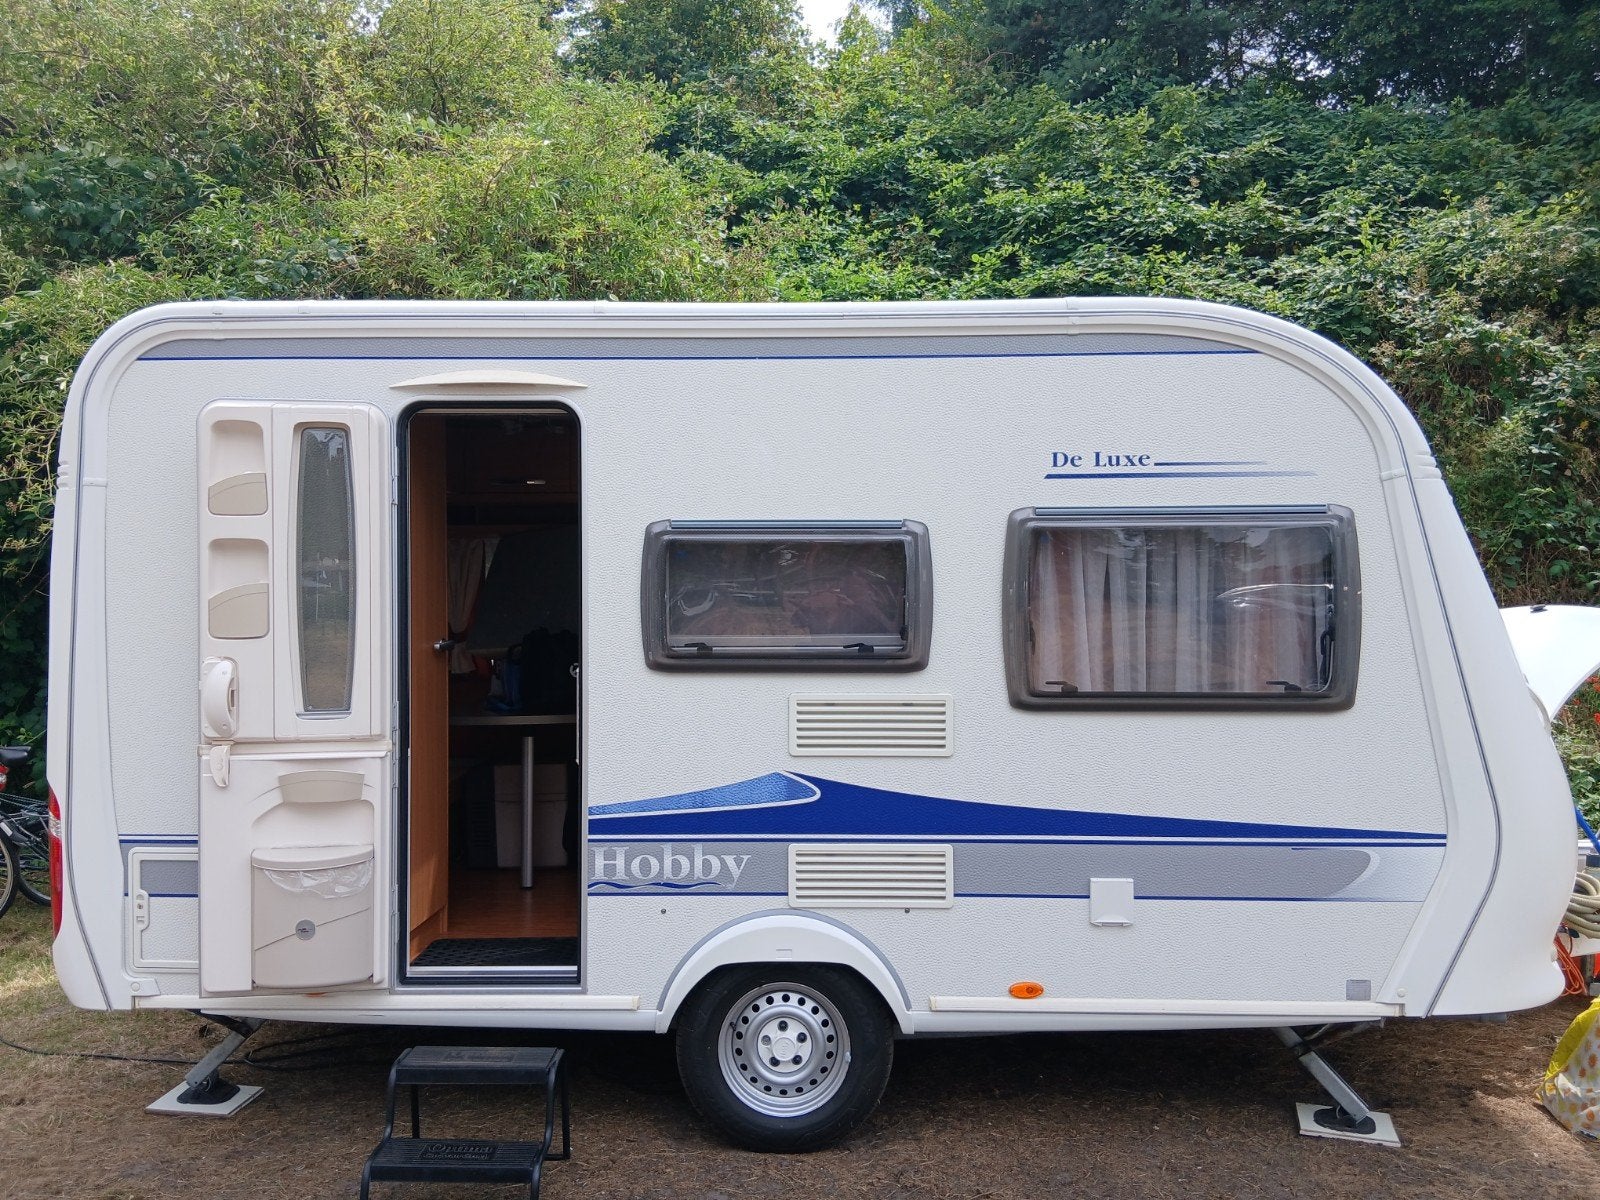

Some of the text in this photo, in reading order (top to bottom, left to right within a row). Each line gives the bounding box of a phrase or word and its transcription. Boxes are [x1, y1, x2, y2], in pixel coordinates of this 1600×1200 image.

[1051, 451, 1151, 468] De Luxe
[590, 843, 752, 890] Hobby
